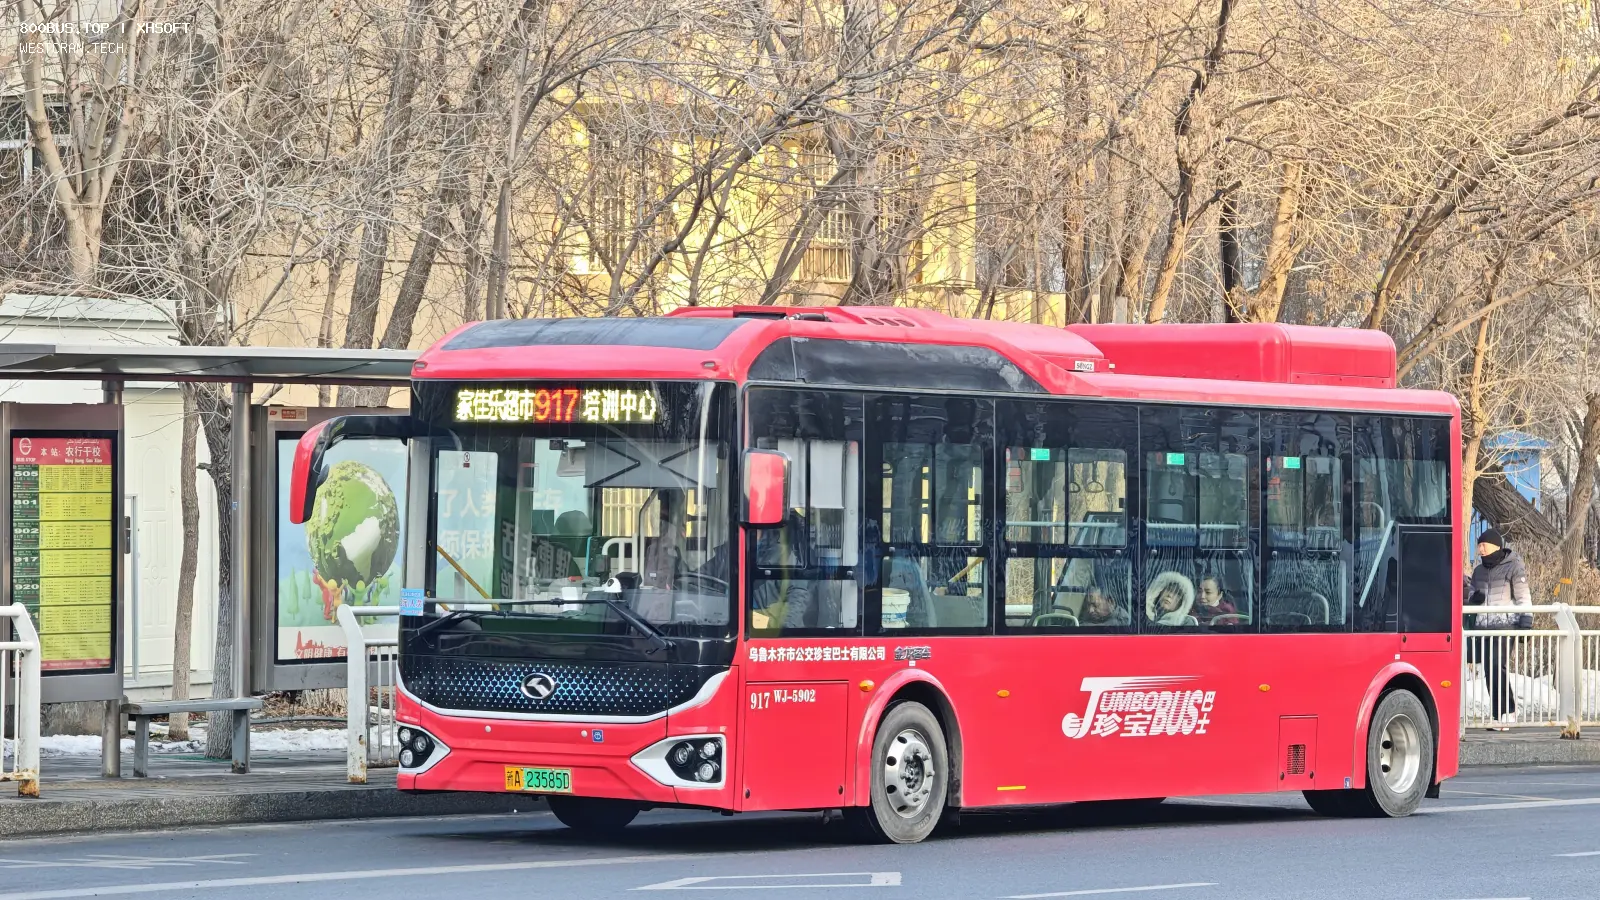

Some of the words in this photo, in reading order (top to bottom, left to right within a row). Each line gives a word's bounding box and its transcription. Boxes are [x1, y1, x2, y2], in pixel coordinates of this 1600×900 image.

[457, 389, 534, 421] 家佳乐超市
[535, 389, 578, 421] 917
[583, 390, 656, 421] 培训中心
[749, 646, 886, 662] 乌鲁木齐市公交珍宝巴士有限公司
[750, 692, 770, 710] 917
[773, 689, 816, 703] WJ-5902
[526, 771, 570, 789] 23585D
